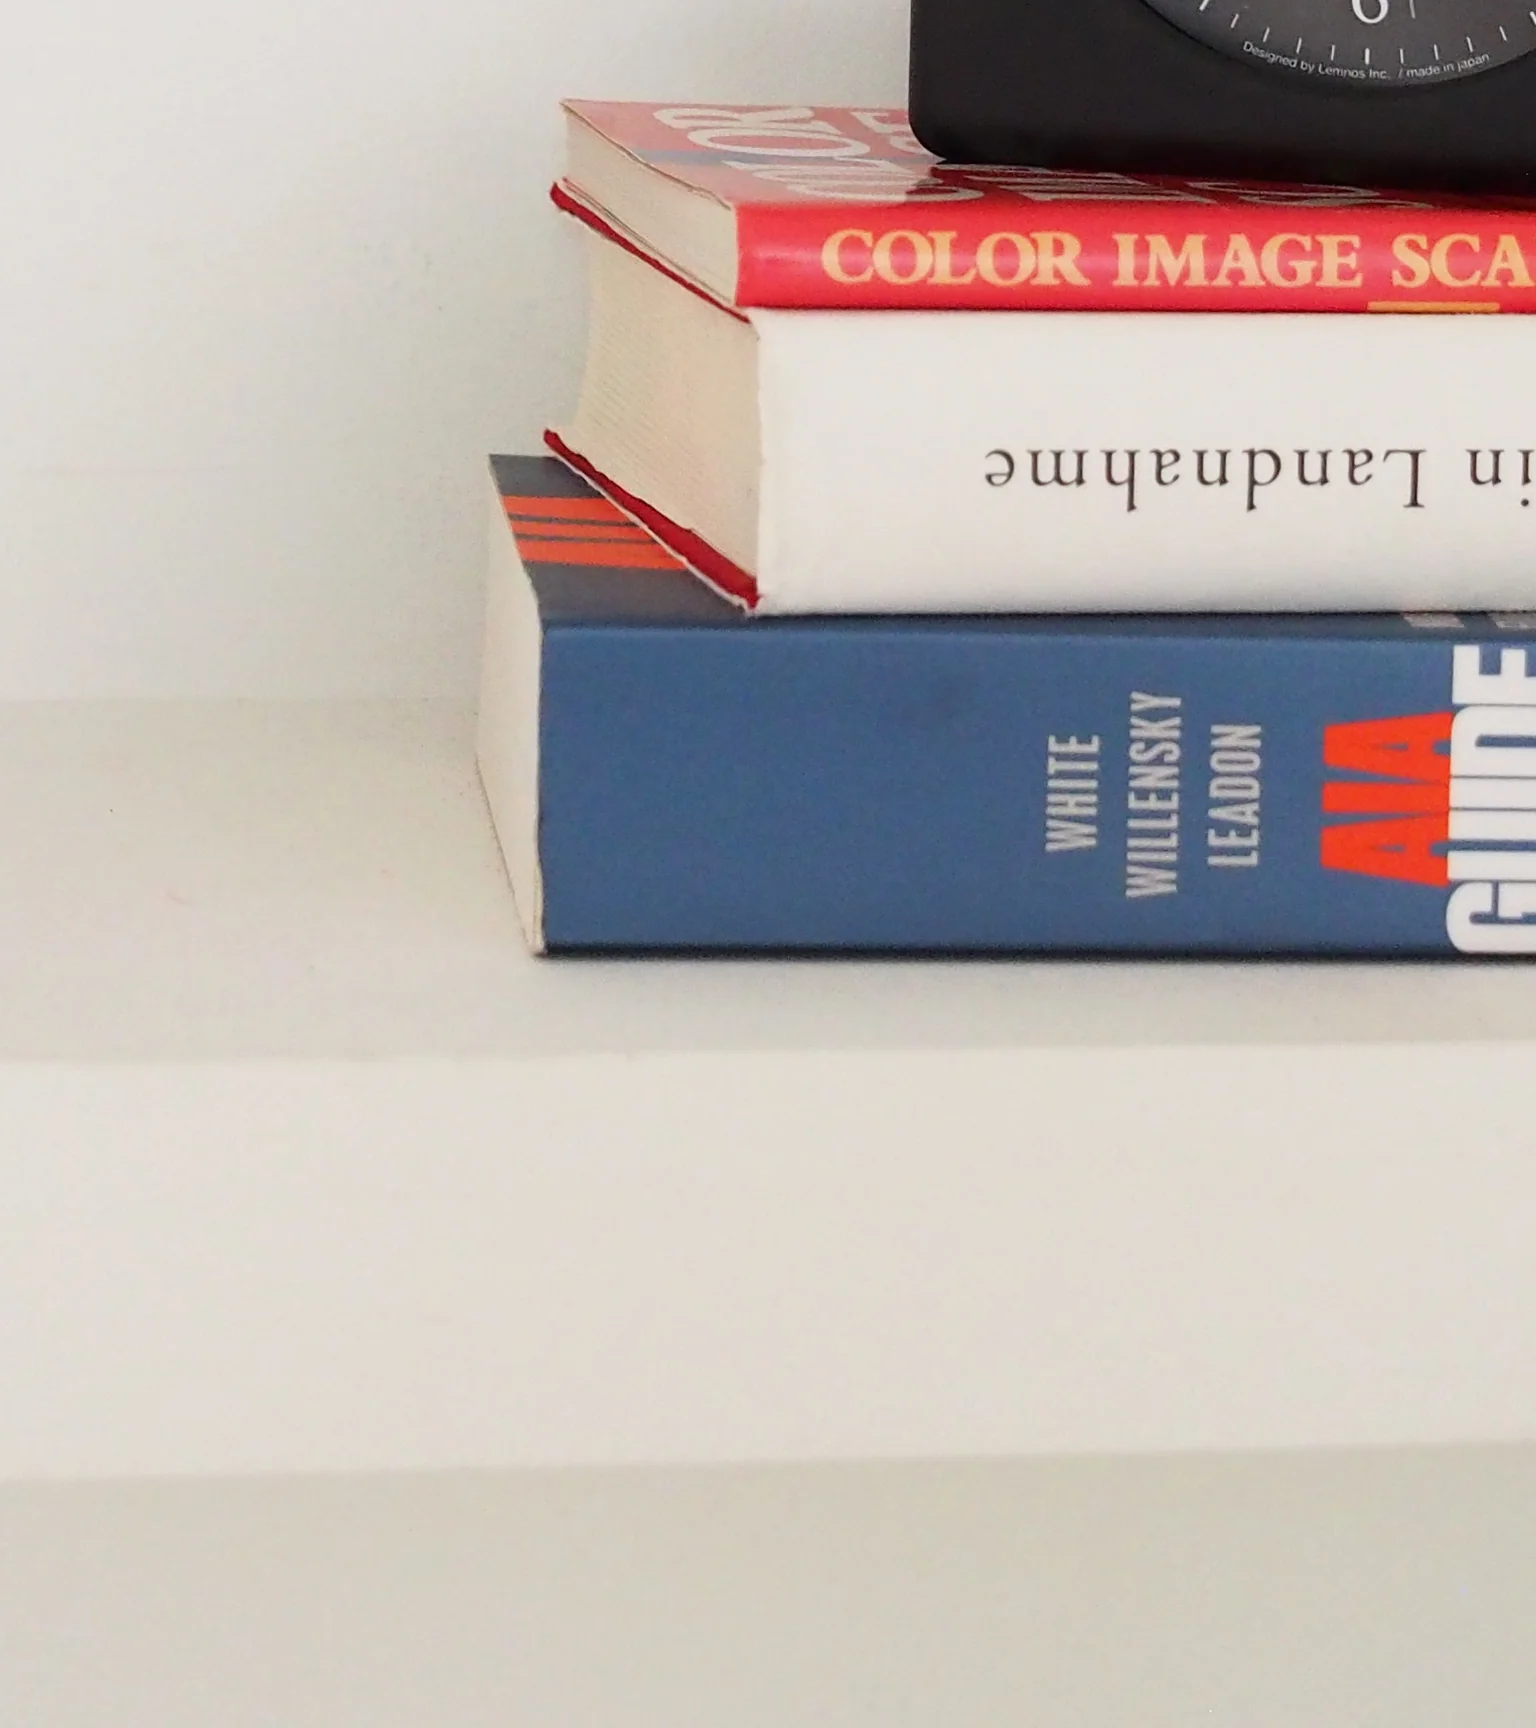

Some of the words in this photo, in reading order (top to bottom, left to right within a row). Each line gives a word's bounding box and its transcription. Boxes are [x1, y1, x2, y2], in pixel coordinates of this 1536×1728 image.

[1242, 40, 1298, 69] Designed
[1300, 60, 1315, 73] by
[1318, 63, 1365, 79] Lemnos
[1406, 65, 1440, 78] made
[1443, 62, 1454, 73] in
[820, 228, 1092, 289] COLOR
[1114, 232, 1364, 289] IMAGE
[983, 446, 1429, 514] Landnahme
[1045, 734, 1101, 853] WHITE
[1125, 690, 1183, 900] WILLENSKY
[1206, 723, 1263, 868] LEADON
[1320, 710, 1454, 888] AIA
